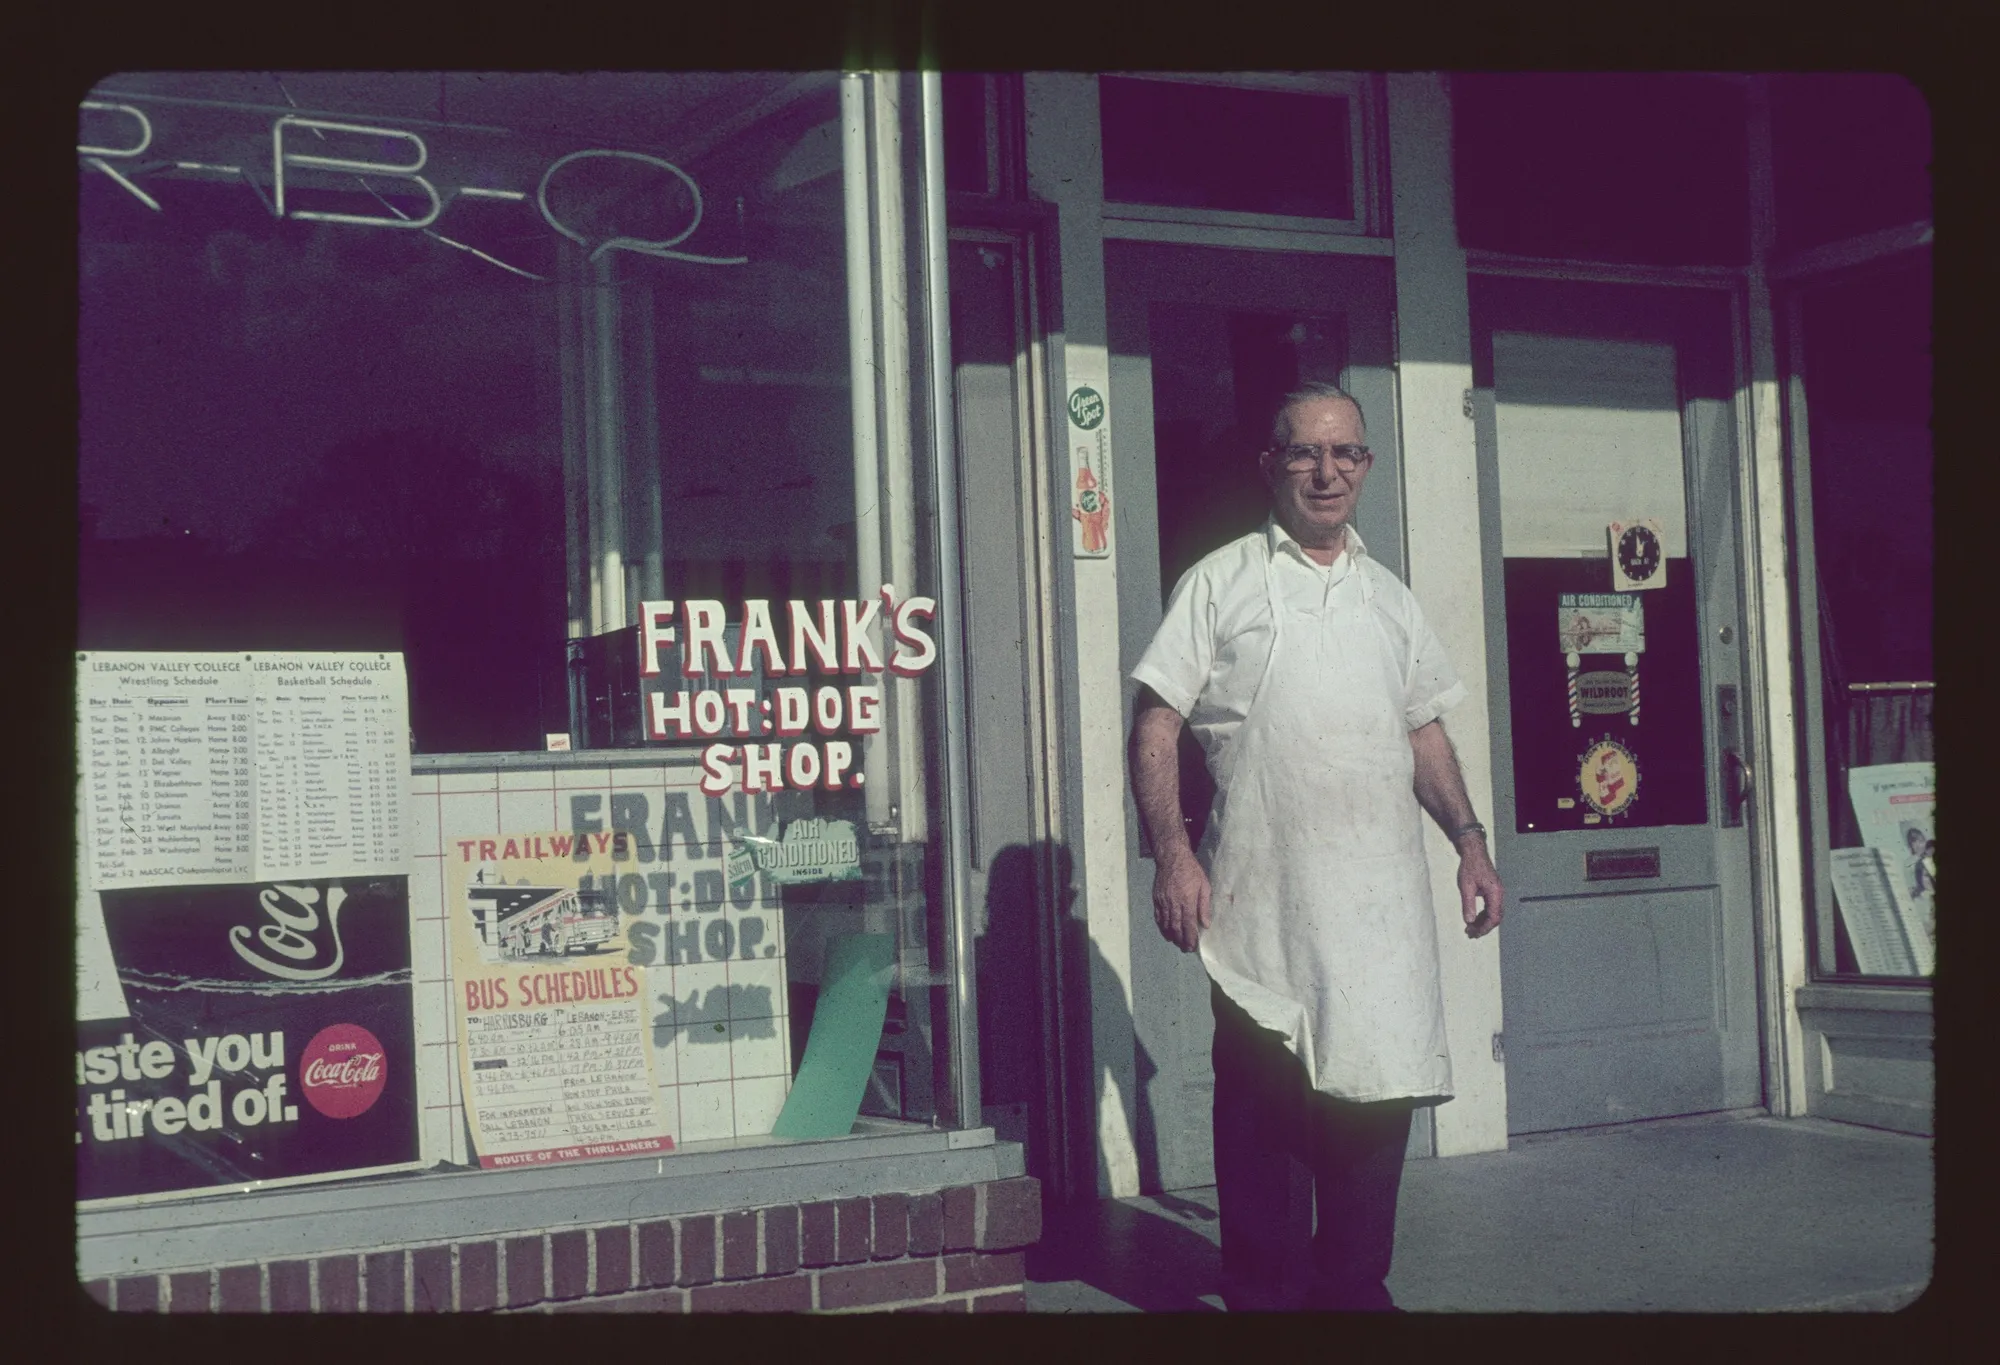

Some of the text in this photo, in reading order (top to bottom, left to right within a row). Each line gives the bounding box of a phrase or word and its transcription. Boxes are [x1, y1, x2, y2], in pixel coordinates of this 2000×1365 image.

[1080, 404, 1101, 426] Spot
[1562, 594, 1633, 607] AIR CONDITIONED
[639, 583, 937, 678] FRANK'S
[93, 662, 241, 672] LEBANON VALLEY COLLEGE
[254, 661, 392, 672] LEBANON VALLEY COLLEGE
[120, 676, 219, 688] Wrestling Schedule
[277, 675, 373, 687] Basketball Schedule
[1580, 686, 1629, 699] WILDROOT
[648, 685, 882, 739] HOT:DOG
[208, 735, 228, 743] Home
[700, 741, 866, 796] SHOP.
[211, 779, 230, 787] Home
[213, 812, 231, 820] Home
[793, 819, 821, 841] AIR
[214, 845, 232, 853] Home
[457, 831, 629, 863] TRAILWAYS
[757, 840, 860, 870] CONDITIONED
[792, 867, 824, 877] INSIDE
[466, 966, 640, 1012] BUS SCHEDULES
[483, 1011, 548, 1032] HARRISBURG
[328, 1042, 357, 1054] DRINK
[184, 1031, 285, 1086] you
[304, 1051, 383, 1089] Coca-Cola
[563, 1073, 637, 1089] FROM LEBANON
[87, 1074, 299, 1142] tired of.
[504, 1116, 551, 1131] LEBANON
[494, 1140, 663, 1165] ROUTE OF THE THRU-LINERS
